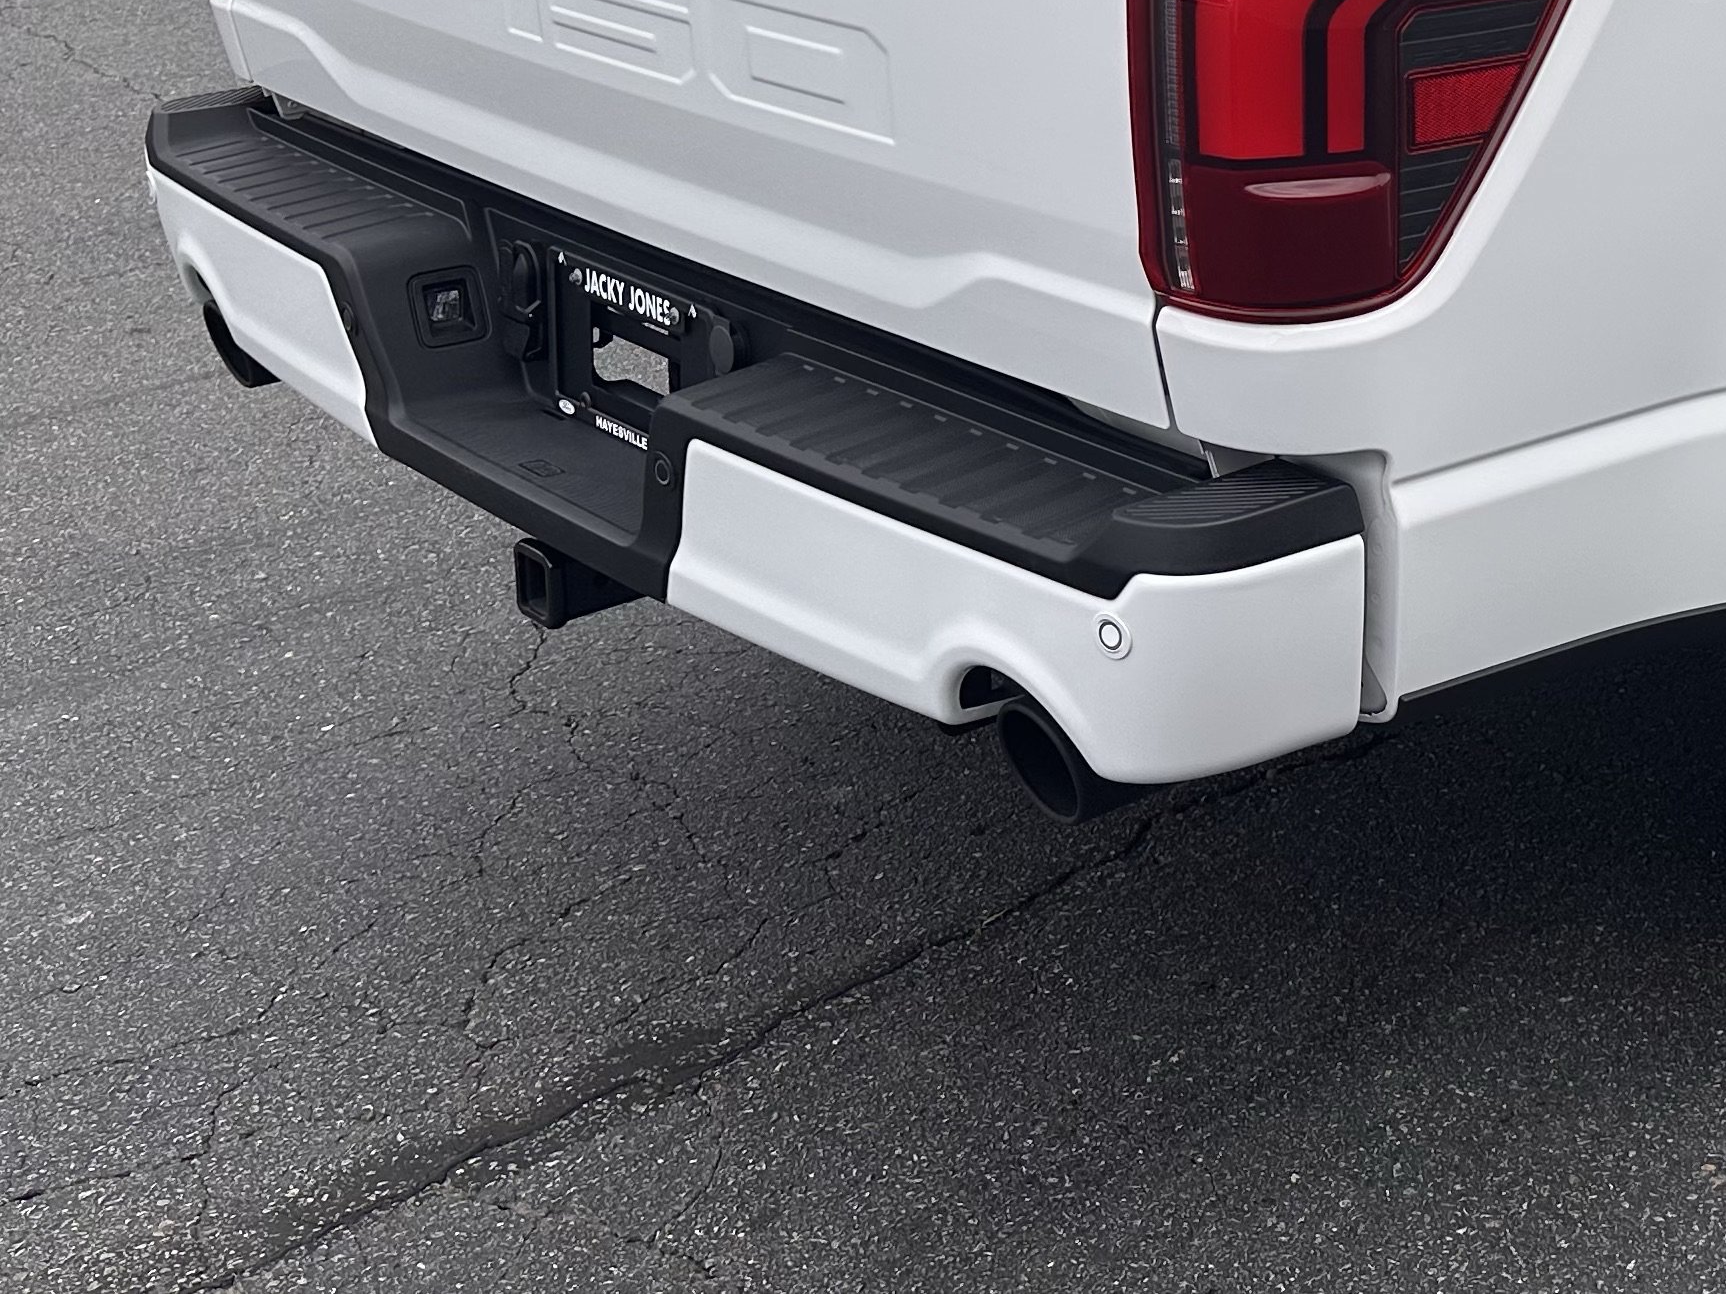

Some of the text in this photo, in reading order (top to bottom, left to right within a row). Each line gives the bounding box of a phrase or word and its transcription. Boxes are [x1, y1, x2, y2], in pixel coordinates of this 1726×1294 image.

[584, 267, 671, 326] JACKY JONES
[595, 415, 648, 451] HAYESVILLE
